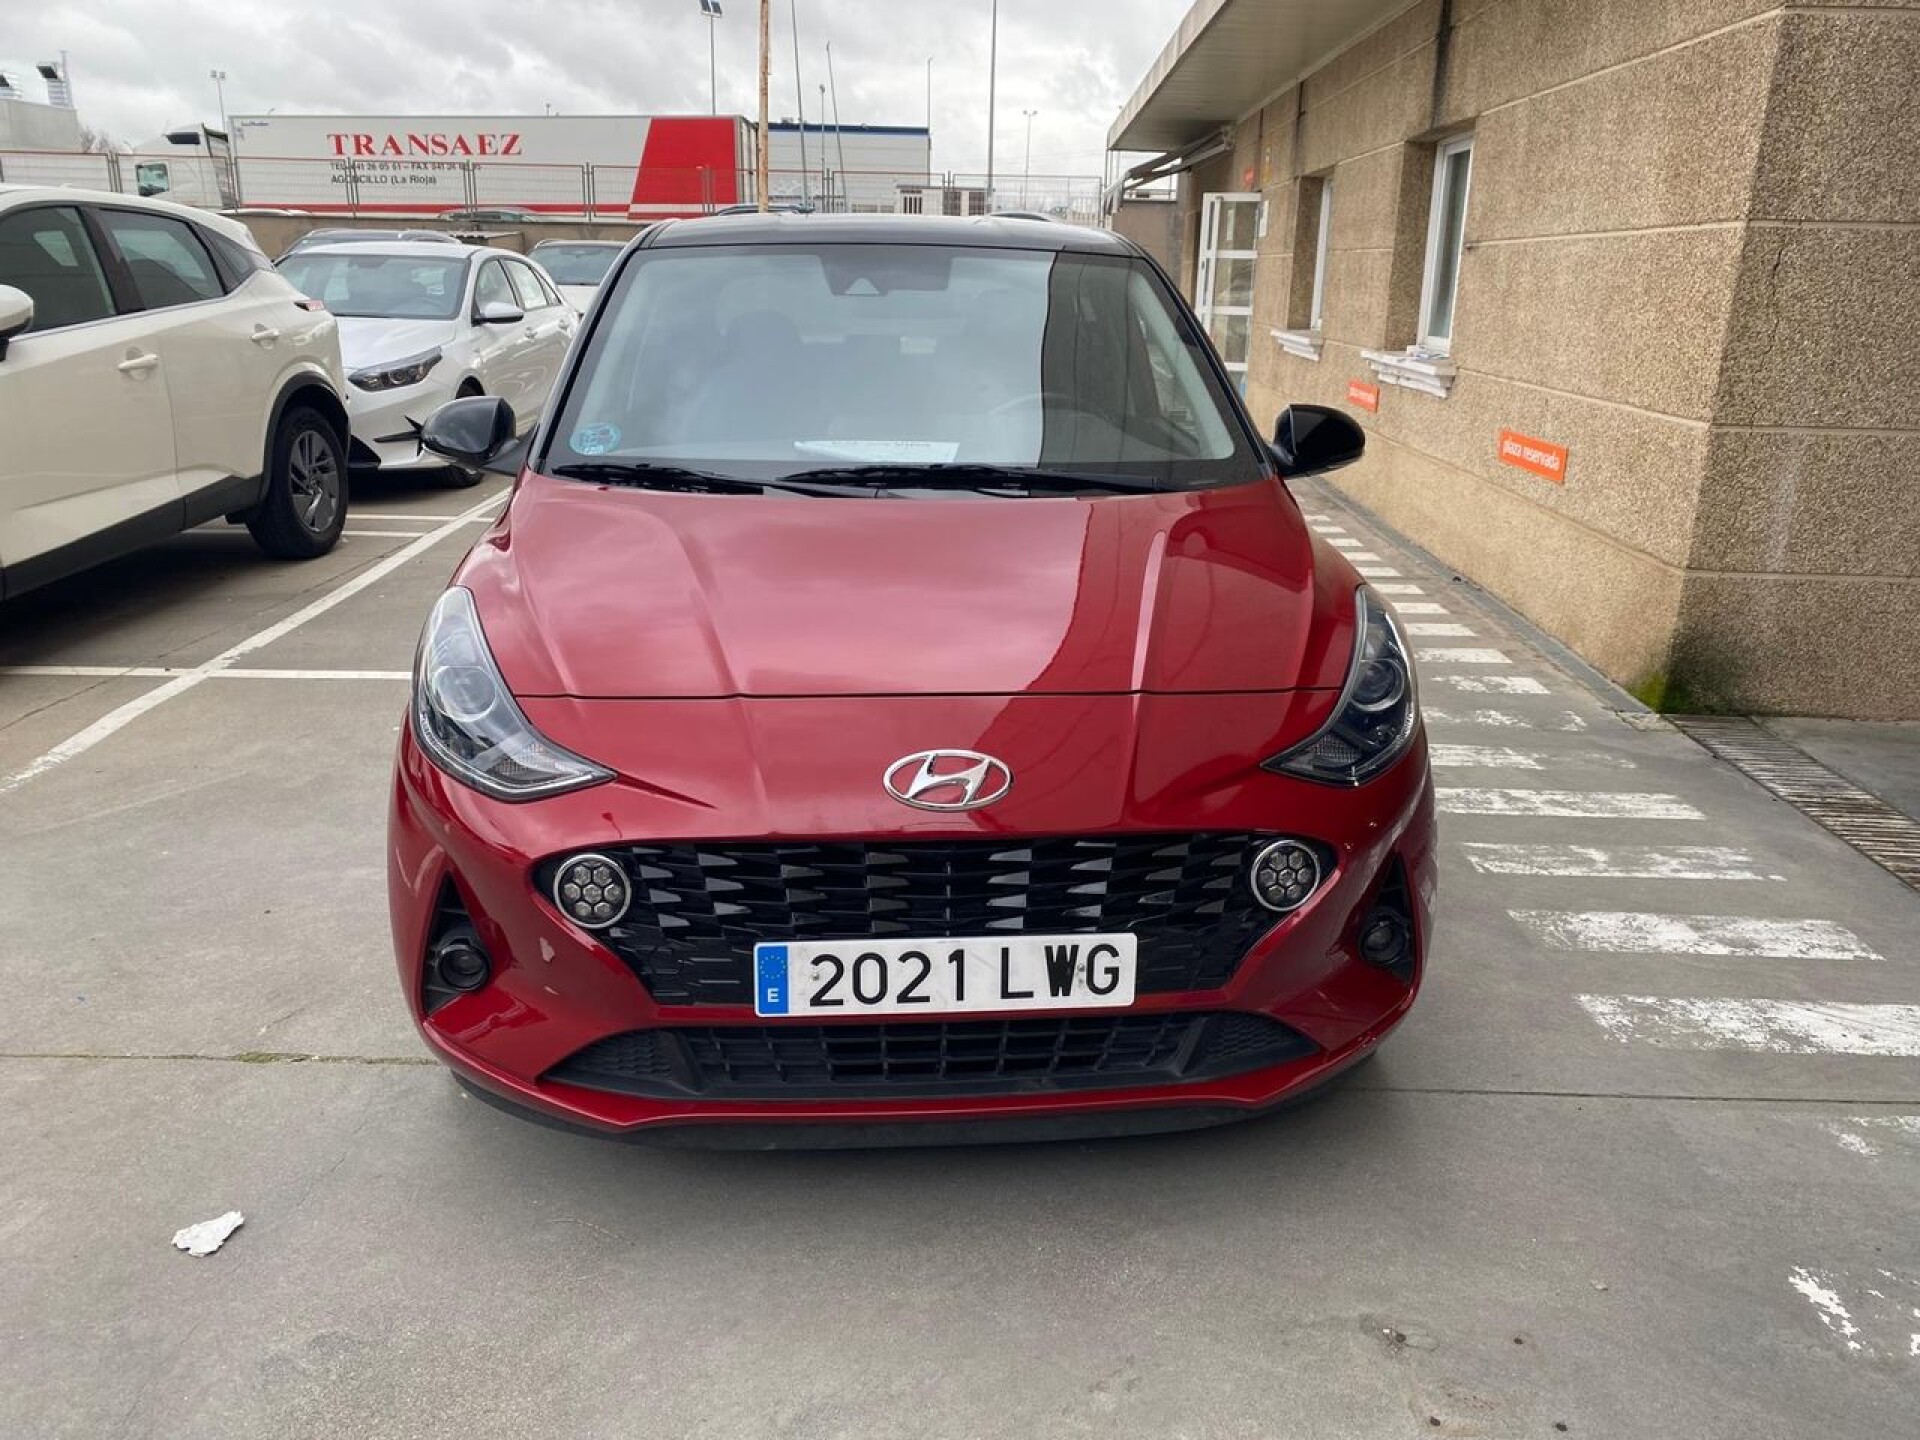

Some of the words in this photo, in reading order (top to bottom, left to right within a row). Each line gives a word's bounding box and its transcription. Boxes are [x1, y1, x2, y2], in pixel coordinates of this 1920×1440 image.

[326, 133, 523, 156] TRANSAEZ
[809, 948, 965, 1007] 2021
[1000, 943, 1120, 1000] LWG
[766, 987, 780, 1003] E
